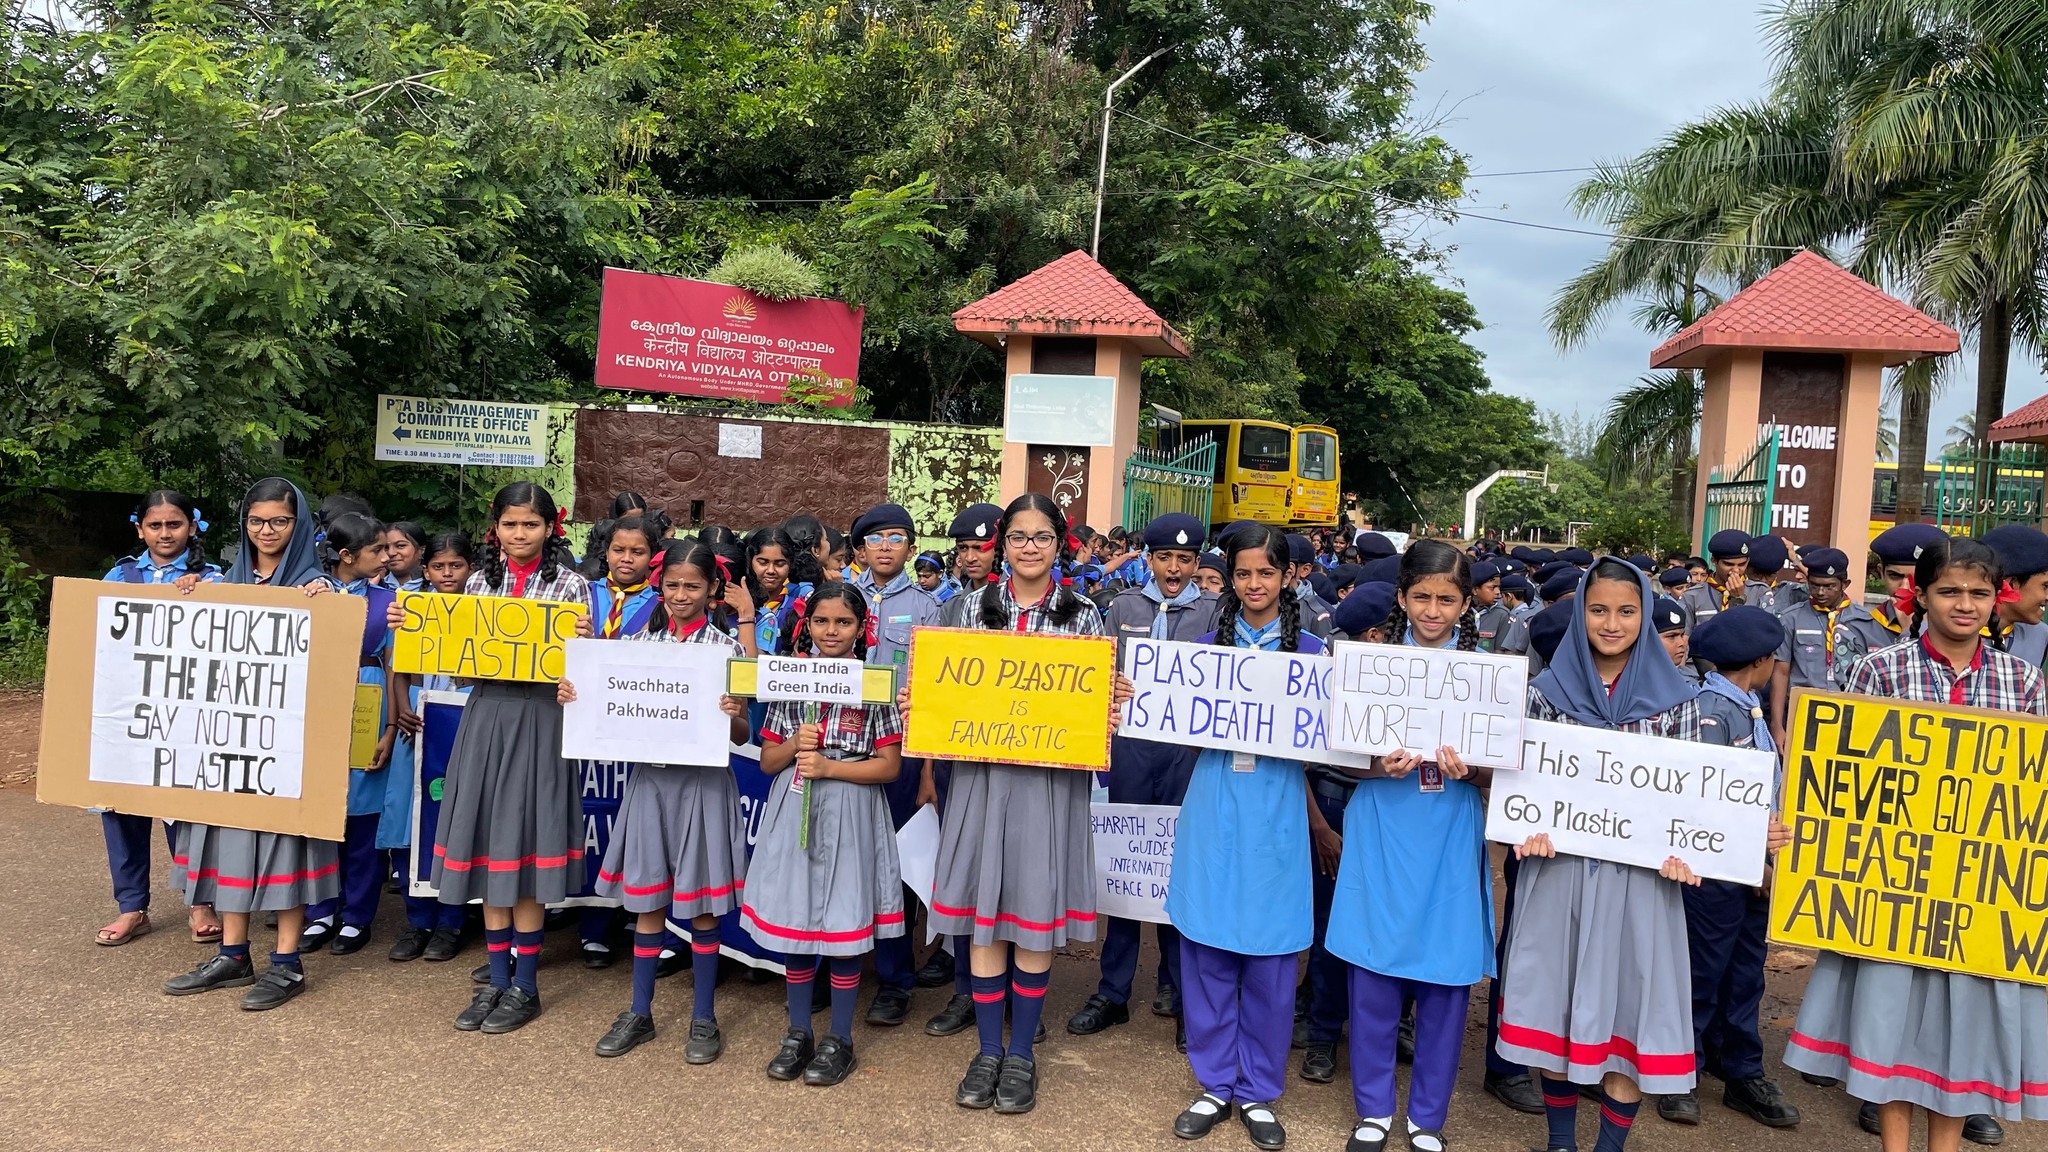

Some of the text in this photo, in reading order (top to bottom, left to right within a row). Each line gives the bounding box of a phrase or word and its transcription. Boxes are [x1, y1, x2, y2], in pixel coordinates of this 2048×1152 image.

[643, 333, 689, 356] केन्द्रीय
[697, 338, 746, 363] विद्यालय
[701, 327, 773, 347] വിദ്യാലയം
[777, 338, 835, 354] ഒറ്റപ്പാലം
[615, 354, 686, 372] KENDRIYA
[691, 362, 763, 380] VIDYALAYA
[667, 373, 702, 382] Autonomous
[386, 398, 539, 421] PTA BUS MANAGEMENT
[397, 412, 529, 432] COMMITTEE OFFICE
[415, 428, 531, 446] KENDRIYA VIDYALAYA
[1757, 423, 1837, 450] WELCOME
[467, 456, 494, 464] Secretary
[472, 451, 495, 459] Contact
[1776, 464, 1806, 489] TO
[1771, 504, 1810, 529] THE
[110, 600, 309, 657] STOP CHOKING
[400, 593, 462, 635] SAY
[475, 599, 530, 638] NO
[420, 636, 563, 681] PLASTIC
[768, 659, 849, 675] Clean India
[1132, 643, 1256, 692] PLASTIC
[133, 652, 288, 710] THE EARTH
[607, 676, 690, 694] Swachhata
[767, 679, 854, 695] Green India.
[935, 656, 1096, 694] NO PLASTIC
[127, 702, 179, 742] SAY
[606, 702, 689, 720] Pakhwada
[1008, 700, 1028, 716] IS
[1127, 691, 1151, 728] IS
[1159, 693, 1177, 733] A
[1189, 696, 1274, 744] DEATH
[948, 720, 1067, 751] FANTASTIC
[1342, 702, 1506, 758] MORE LIFE
[1802, 698, 2010, 776] PLASTIC
[153, 747, 276, 796] PLASTIC
[1520, 739, 1580, 778] This
[1701, 765, 1770, 810] Plea,
[1796, 755, 1920, 828] NEVER
[1932, 774, 1973, 835] GO
[1091, 815, 1146, 836] BHARATH
[1504, 794, 1542, 824] Go
[1552, 800, 1632, 840] Plastic
[1790, 814, 1934, 894] PLEASE
[1106, 878, 1144, 898] PEACE
[1782, 878, 1974, 964] ANOTHER
